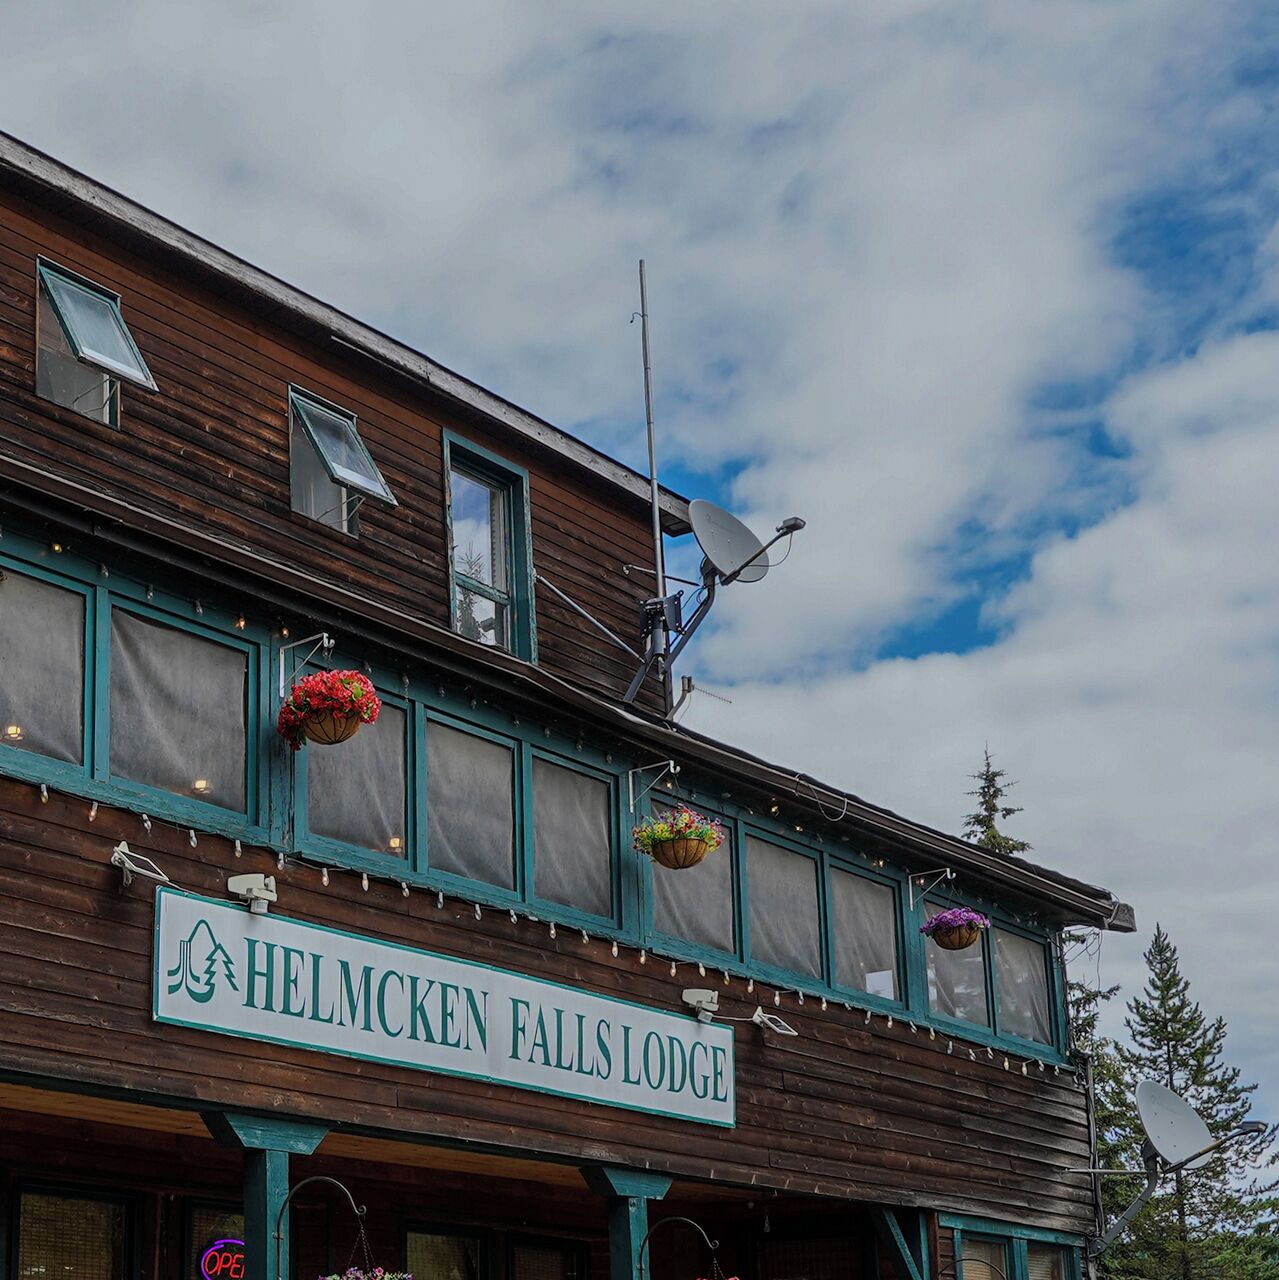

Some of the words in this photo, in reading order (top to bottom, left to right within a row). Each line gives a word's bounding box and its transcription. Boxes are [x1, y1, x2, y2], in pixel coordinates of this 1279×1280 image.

[242, 937, 489, 1054] HELMCKEN
[508, 997, 613, 1080] FALLS
[621, 1024, 728, 1103] LODGE
[205, 1251, 245, 1278] OPE
